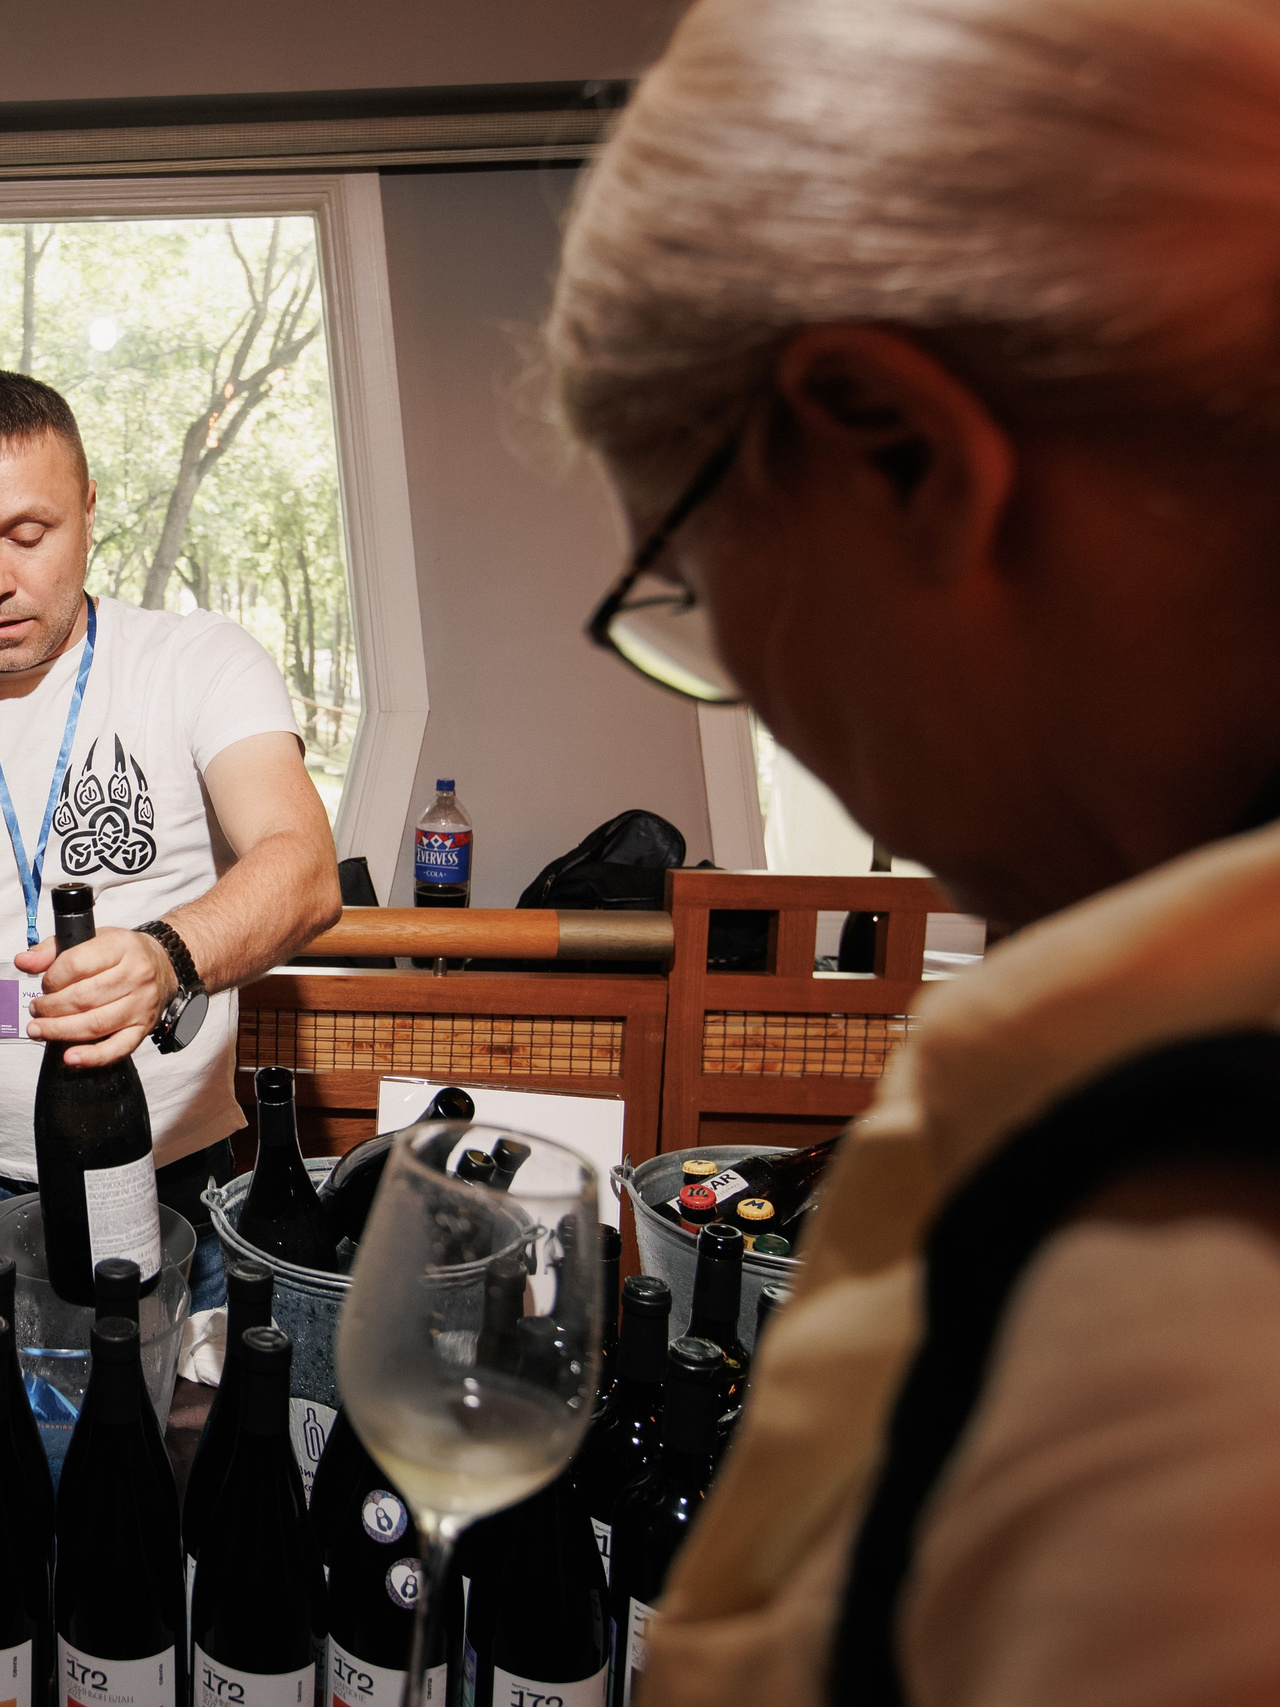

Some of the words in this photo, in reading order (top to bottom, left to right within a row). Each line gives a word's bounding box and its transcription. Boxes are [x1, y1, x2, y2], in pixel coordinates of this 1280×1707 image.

[417, 848, 459, 866] EVERVESS
[426, 870, 444, 878] COLA
[67, 1658, 108, 1691] 172
[203, 1668, 245, 1704] 172
[334, 1656, 374, 1695] 172
[109, 1695, 134, 1703] БЛАН
